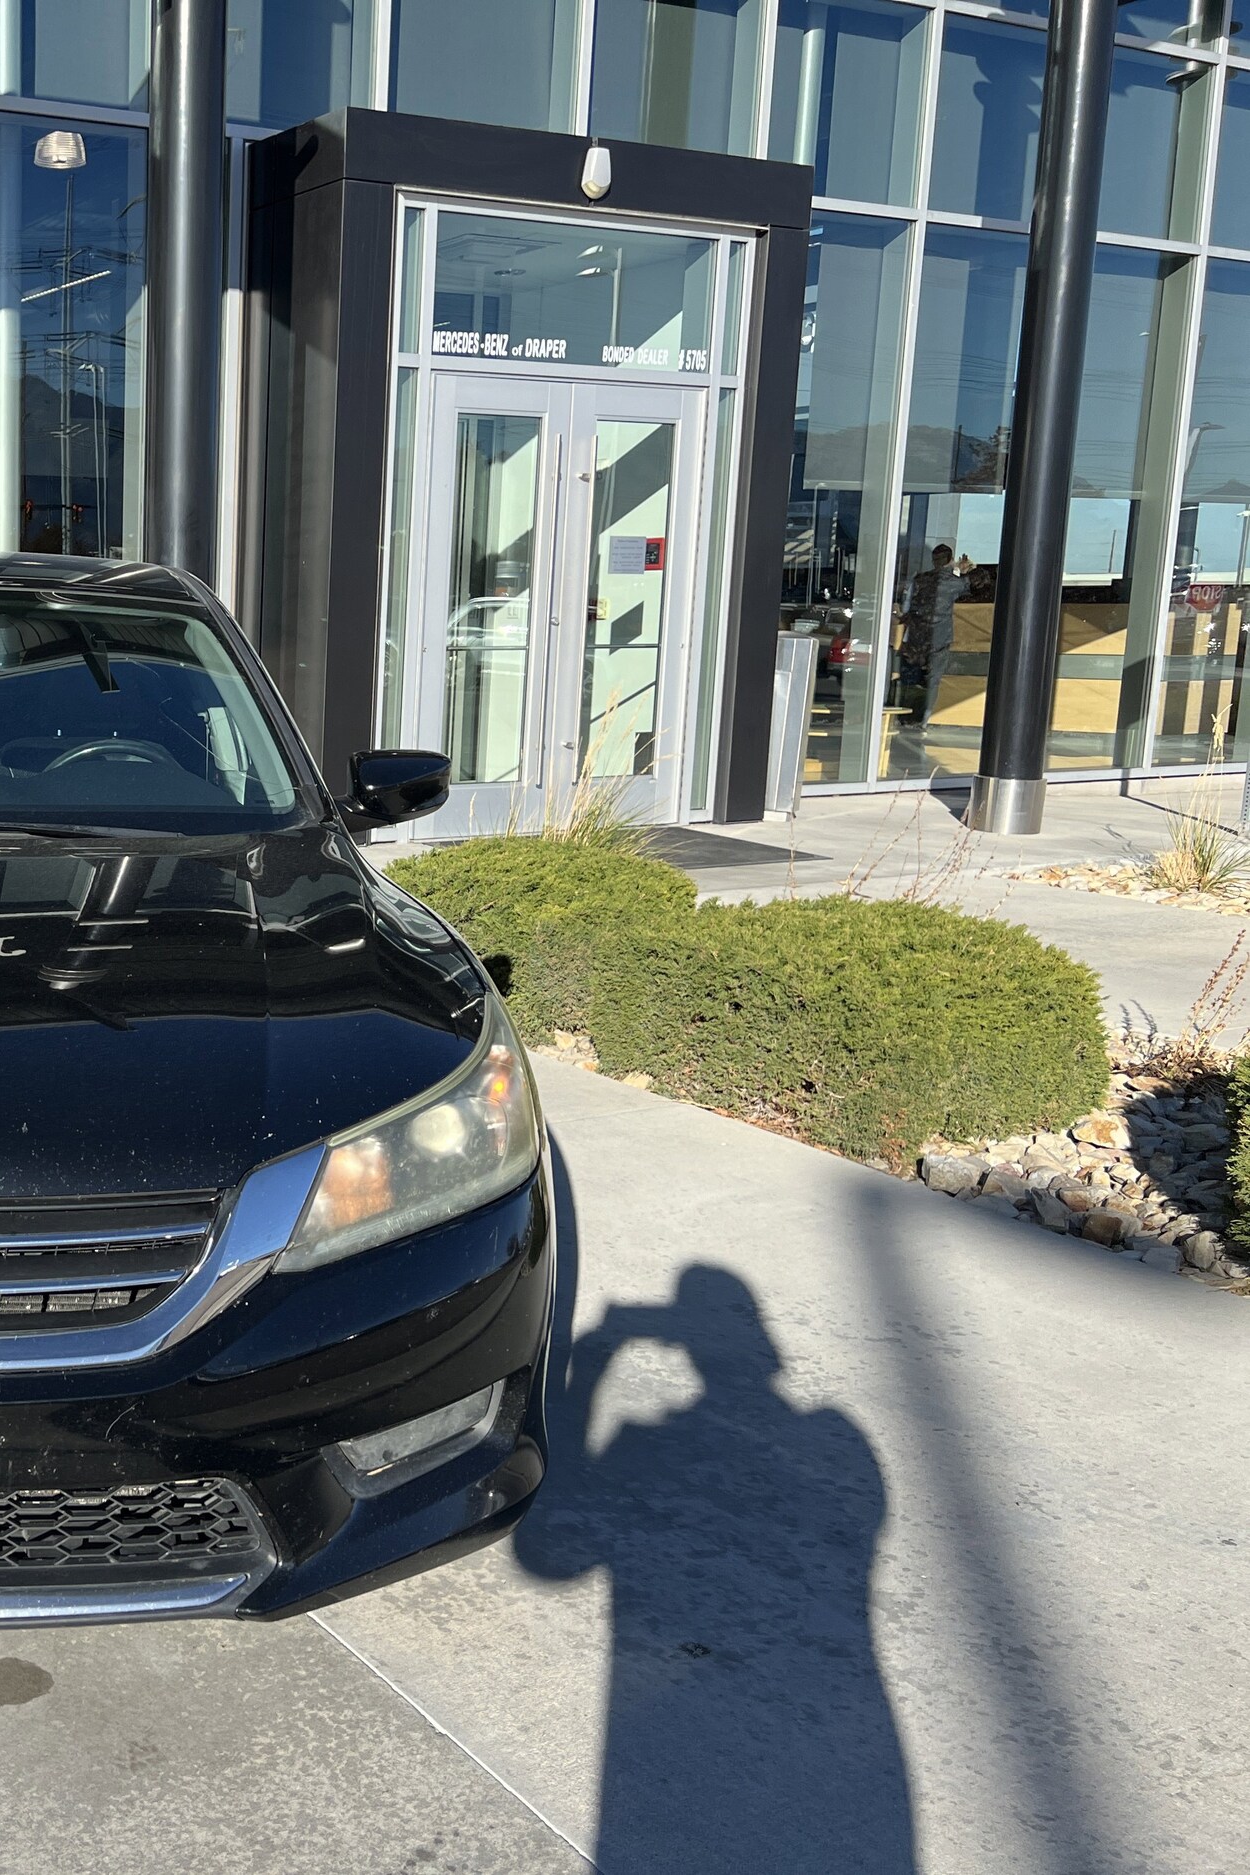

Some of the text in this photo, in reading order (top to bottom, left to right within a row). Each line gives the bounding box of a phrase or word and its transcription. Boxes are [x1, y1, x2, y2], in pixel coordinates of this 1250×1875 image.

[512, 344, 523, 356] of
[525, 338, 566, 359] DRAPER
[602, 345, 635, 363] BONDED
[637, 348, 669, 366] DEALER
